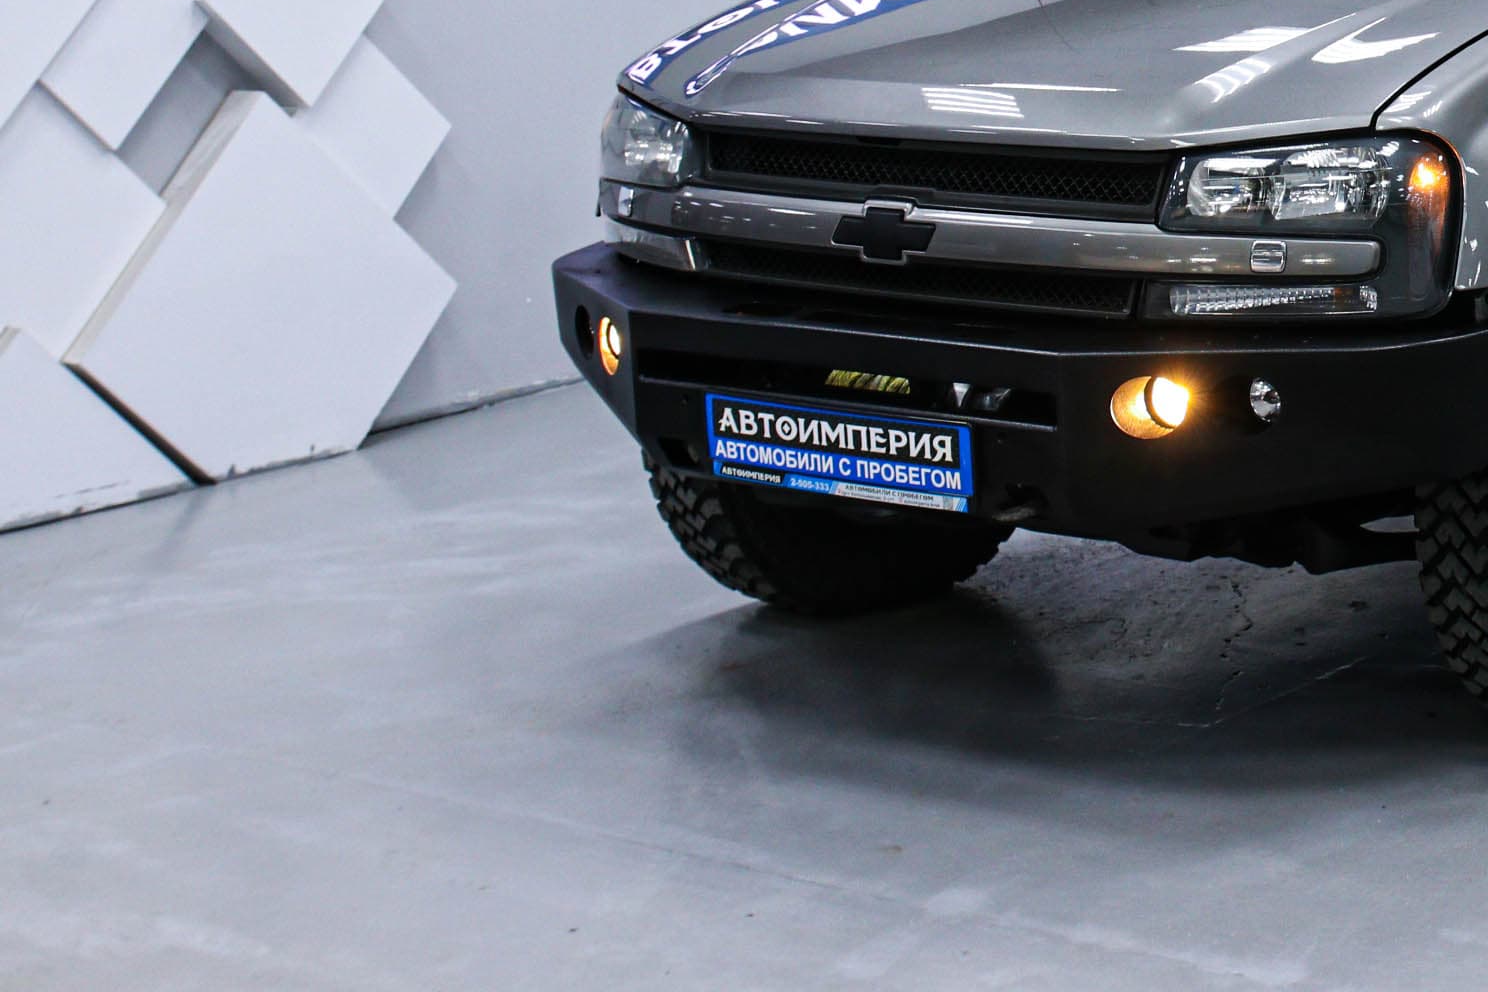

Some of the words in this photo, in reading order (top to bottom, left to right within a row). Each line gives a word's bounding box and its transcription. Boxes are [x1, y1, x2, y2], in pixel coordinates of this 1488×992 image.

[718, 407, 953, 463] АВТОИМПЕРИЯ
[715, 439, 834, 475] АВТОМОБИЛИ
[839, 458, 851, 475] С
[856, 460, 962, 490] ПРОБЕГОМ
